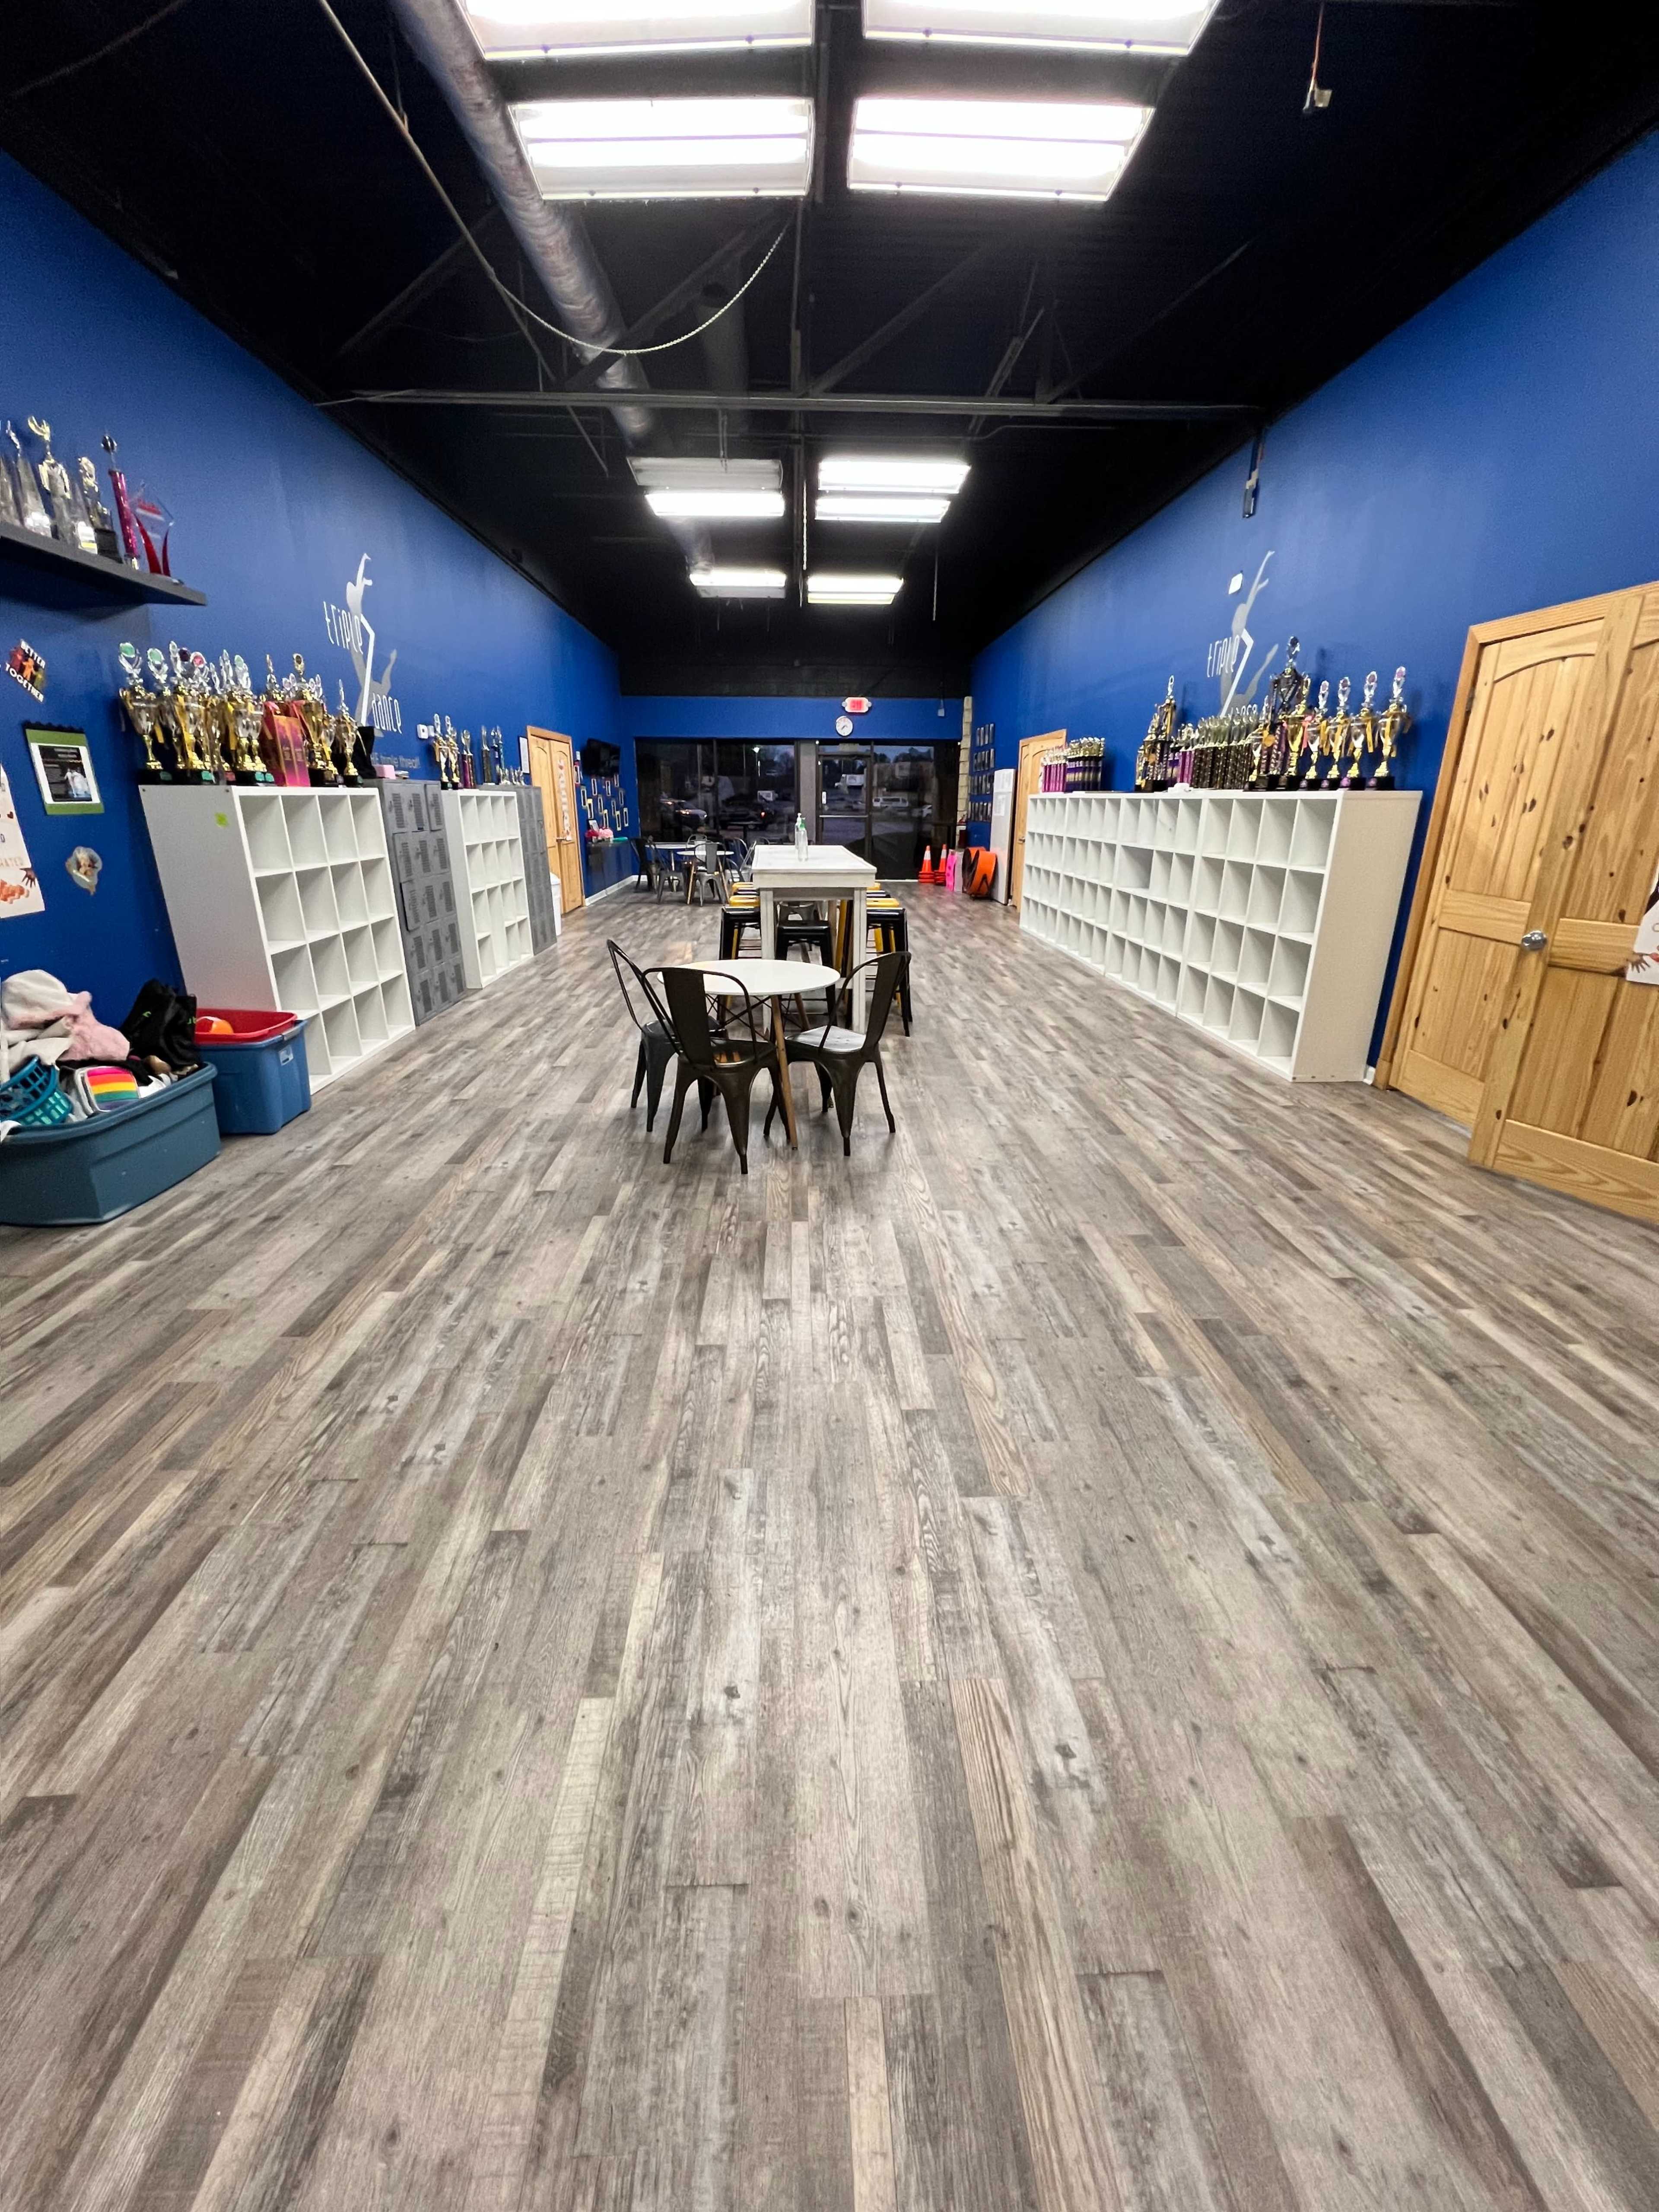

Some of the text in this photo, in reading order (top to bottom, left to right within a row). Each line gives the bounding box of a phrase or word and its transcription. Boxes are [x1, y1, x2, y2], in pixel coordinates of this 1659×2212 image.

[323, 601, 363, 655] triple
[21, 639, 46, 669] BETTER
[1207, 635, 1240, 678] triple
[6, 666, 44, 702] TOGETHER
[372, 693, 402, 734] dance
